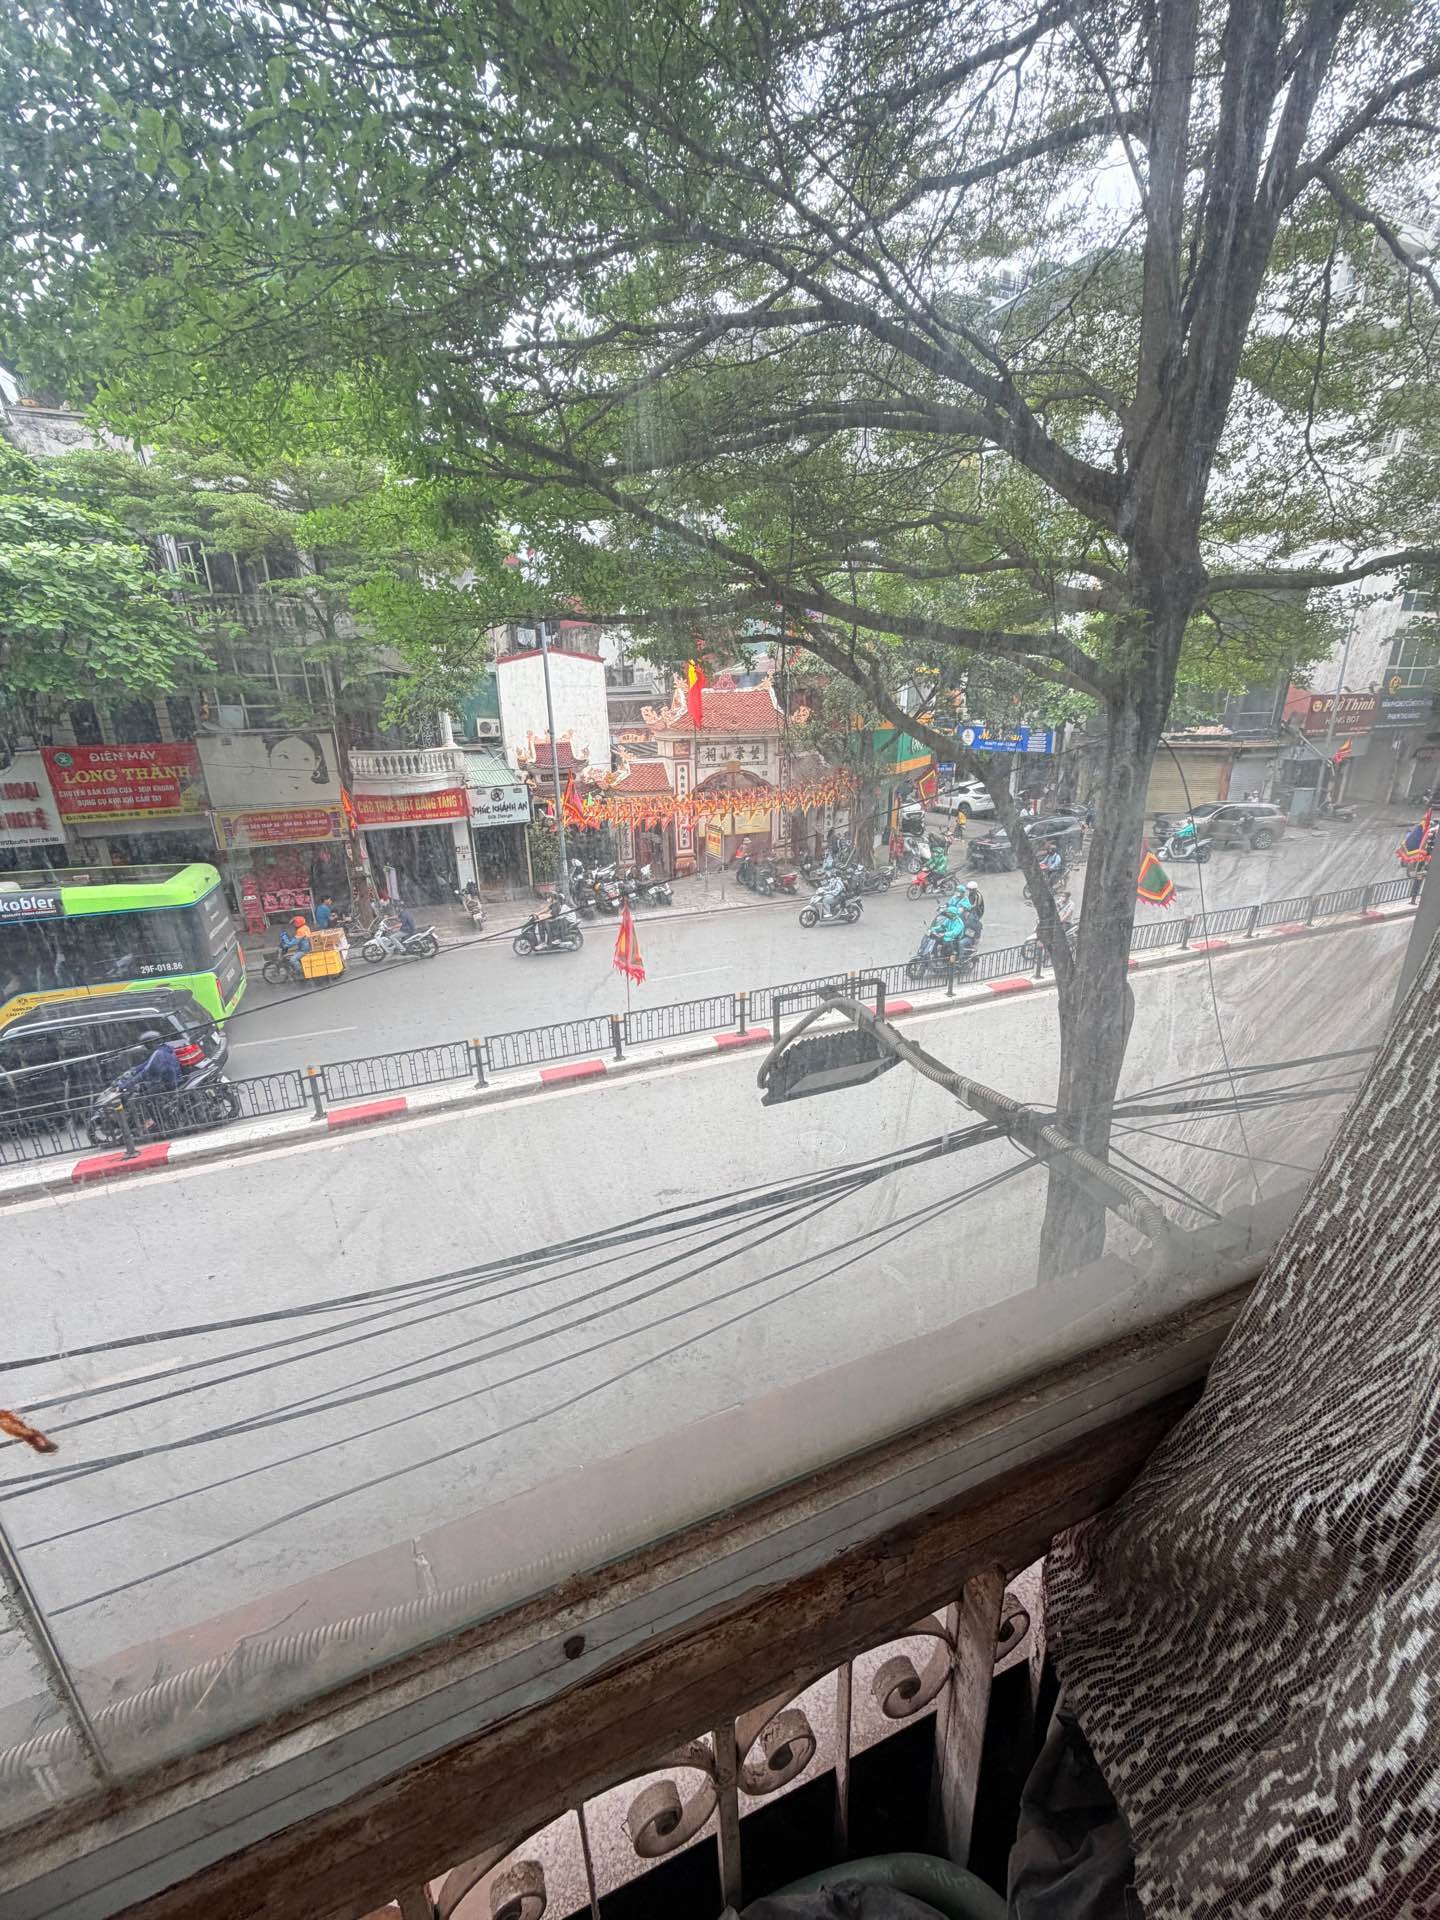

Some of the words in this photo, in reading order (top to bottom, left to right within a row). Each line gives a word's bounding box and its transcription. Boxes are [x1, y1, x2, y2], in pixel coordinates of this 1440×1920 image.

[127, 749, 156, 761] MÁY
[62, 769, 118, 784] LONG
[121, 764, 192, 781] THÀNH
[357, 800, 375, 813] CHO
[459, 794, 463, 806] 1
[492, 801, 516, 813] KHÁNH
[518, 801, 528, 810] AN
[0, 896, 54, 912] kobler
[140, 961, 184, 974] 29F-018.86
